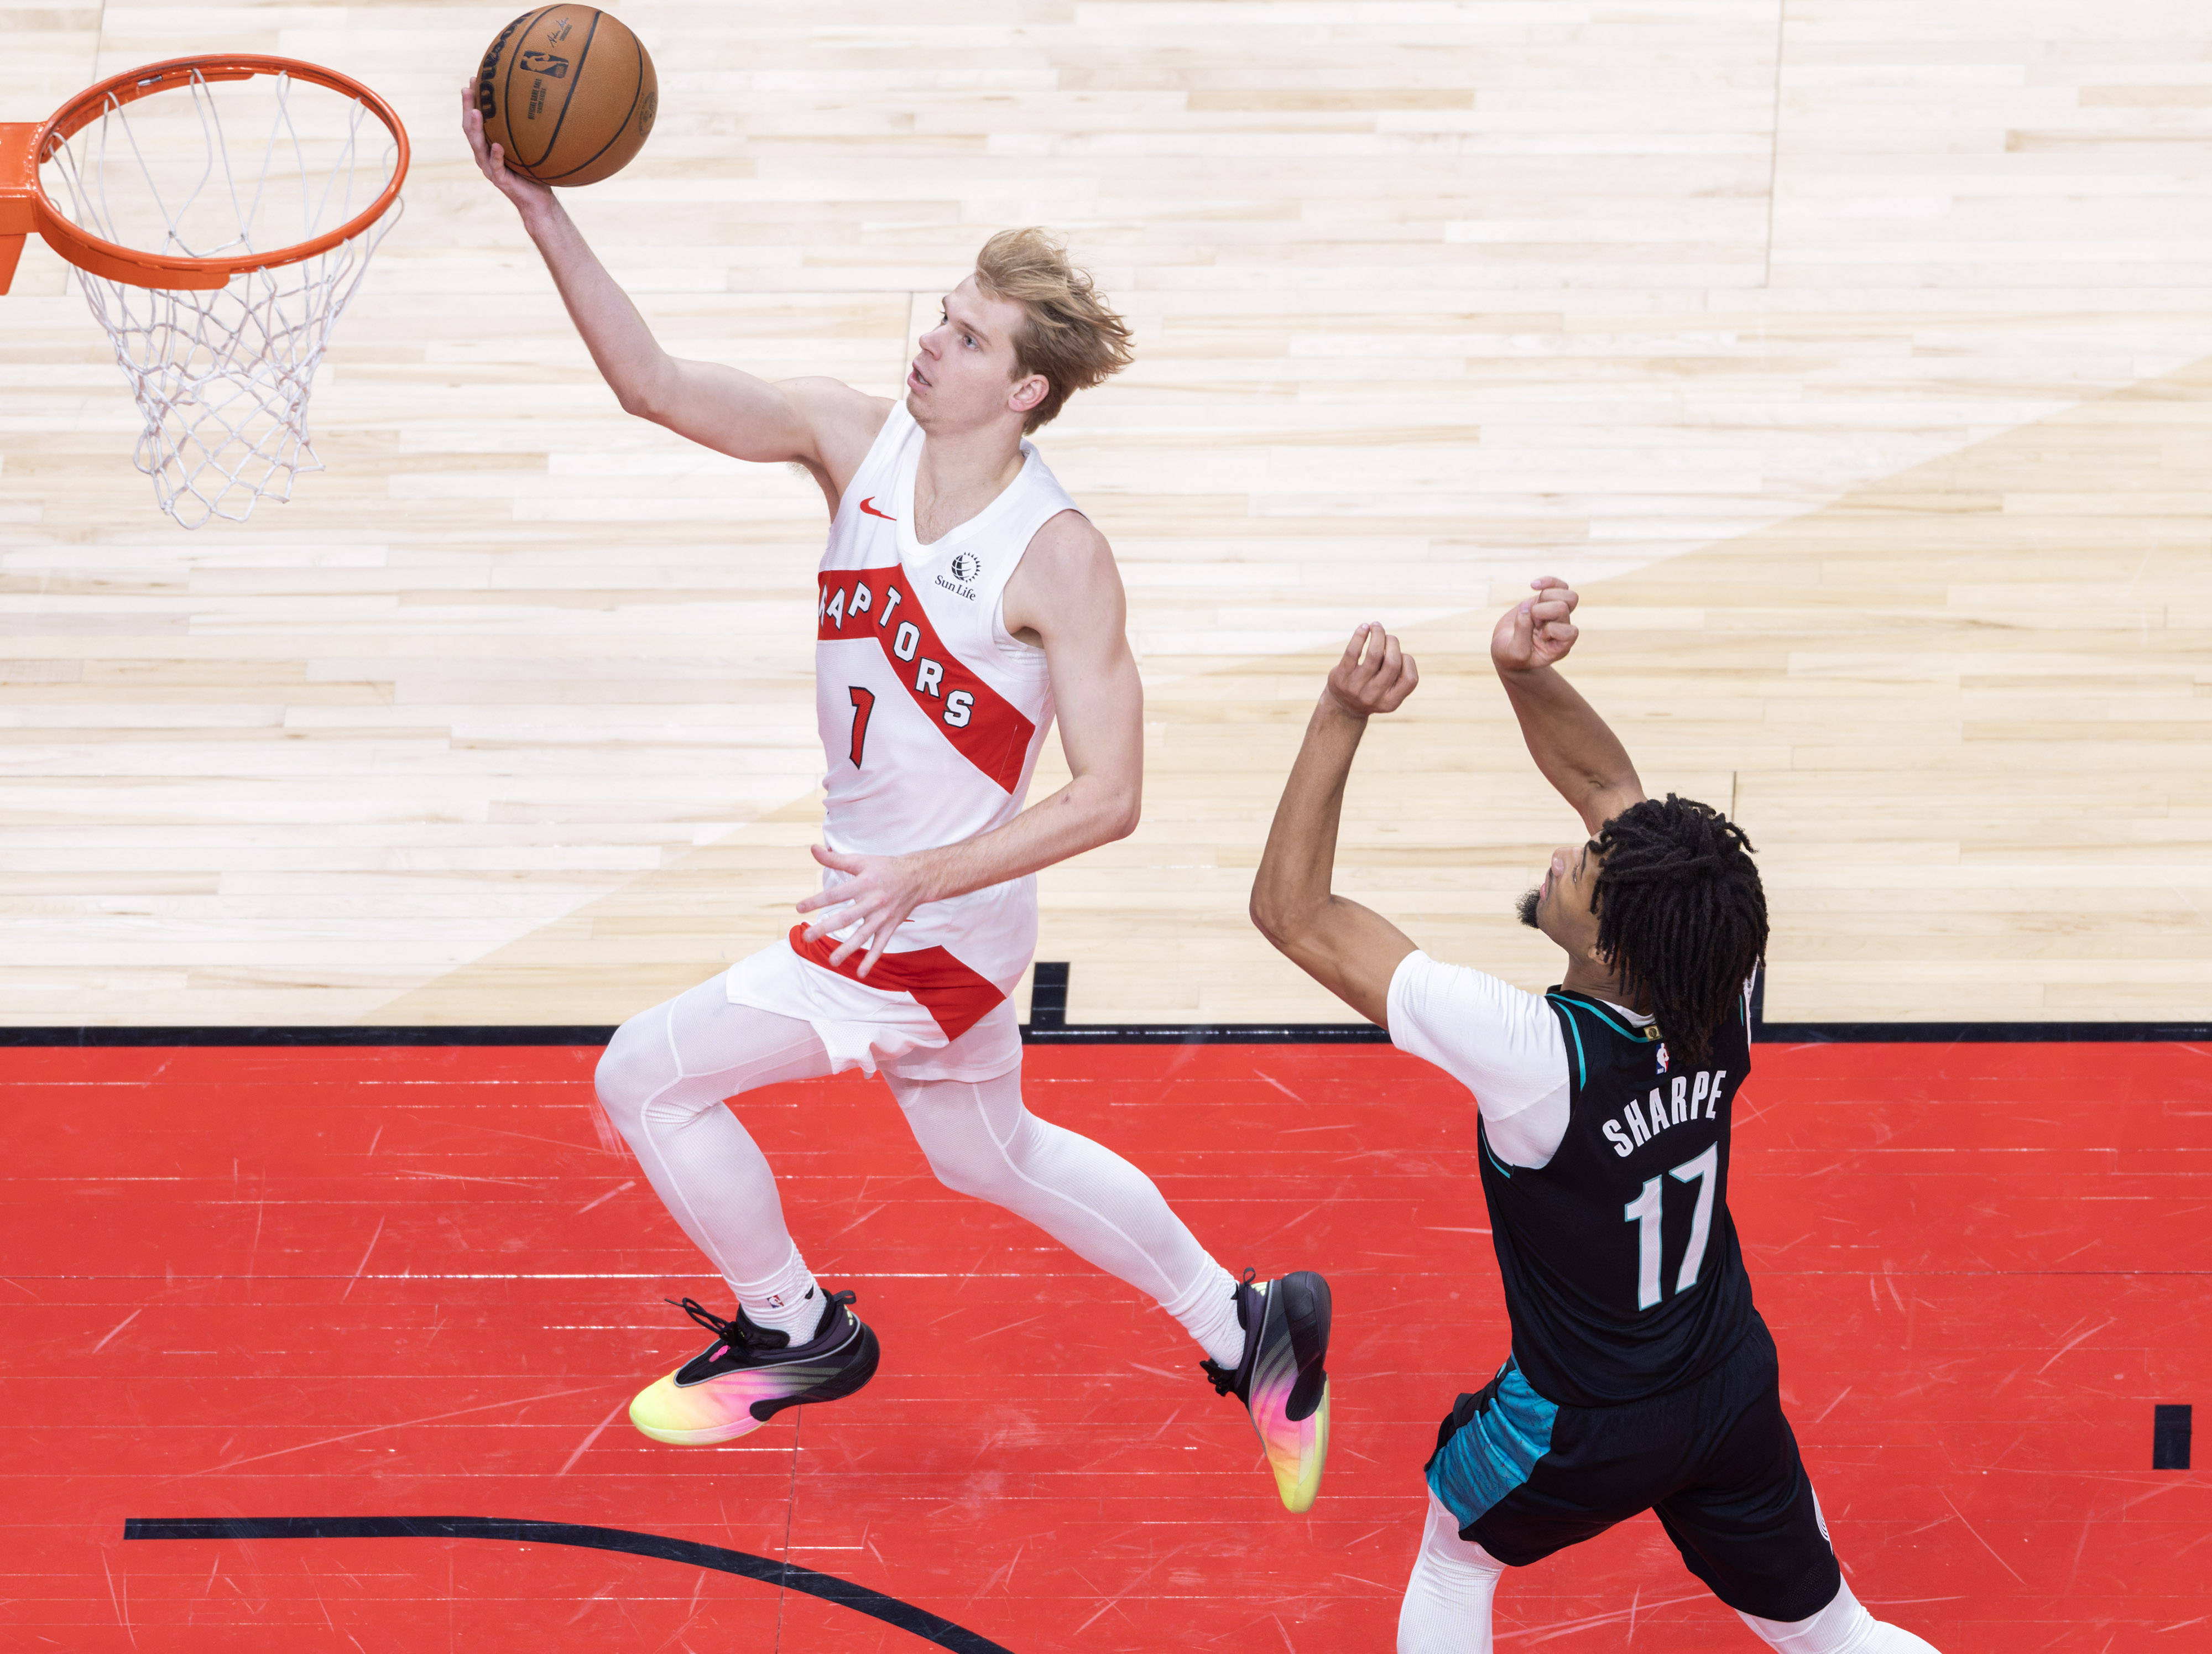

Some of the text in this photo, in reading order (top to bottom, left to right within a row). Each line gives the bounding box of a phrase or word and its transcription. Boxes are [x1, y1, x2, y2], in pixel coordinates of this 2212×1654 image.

[935, 575, 976, 601] Sun Life
[818, 580, 975, 728] RAPTORS
[1603, 1070, 1726, 1157] SHARPE
[1625, 1141, 1718, 1311] 17
